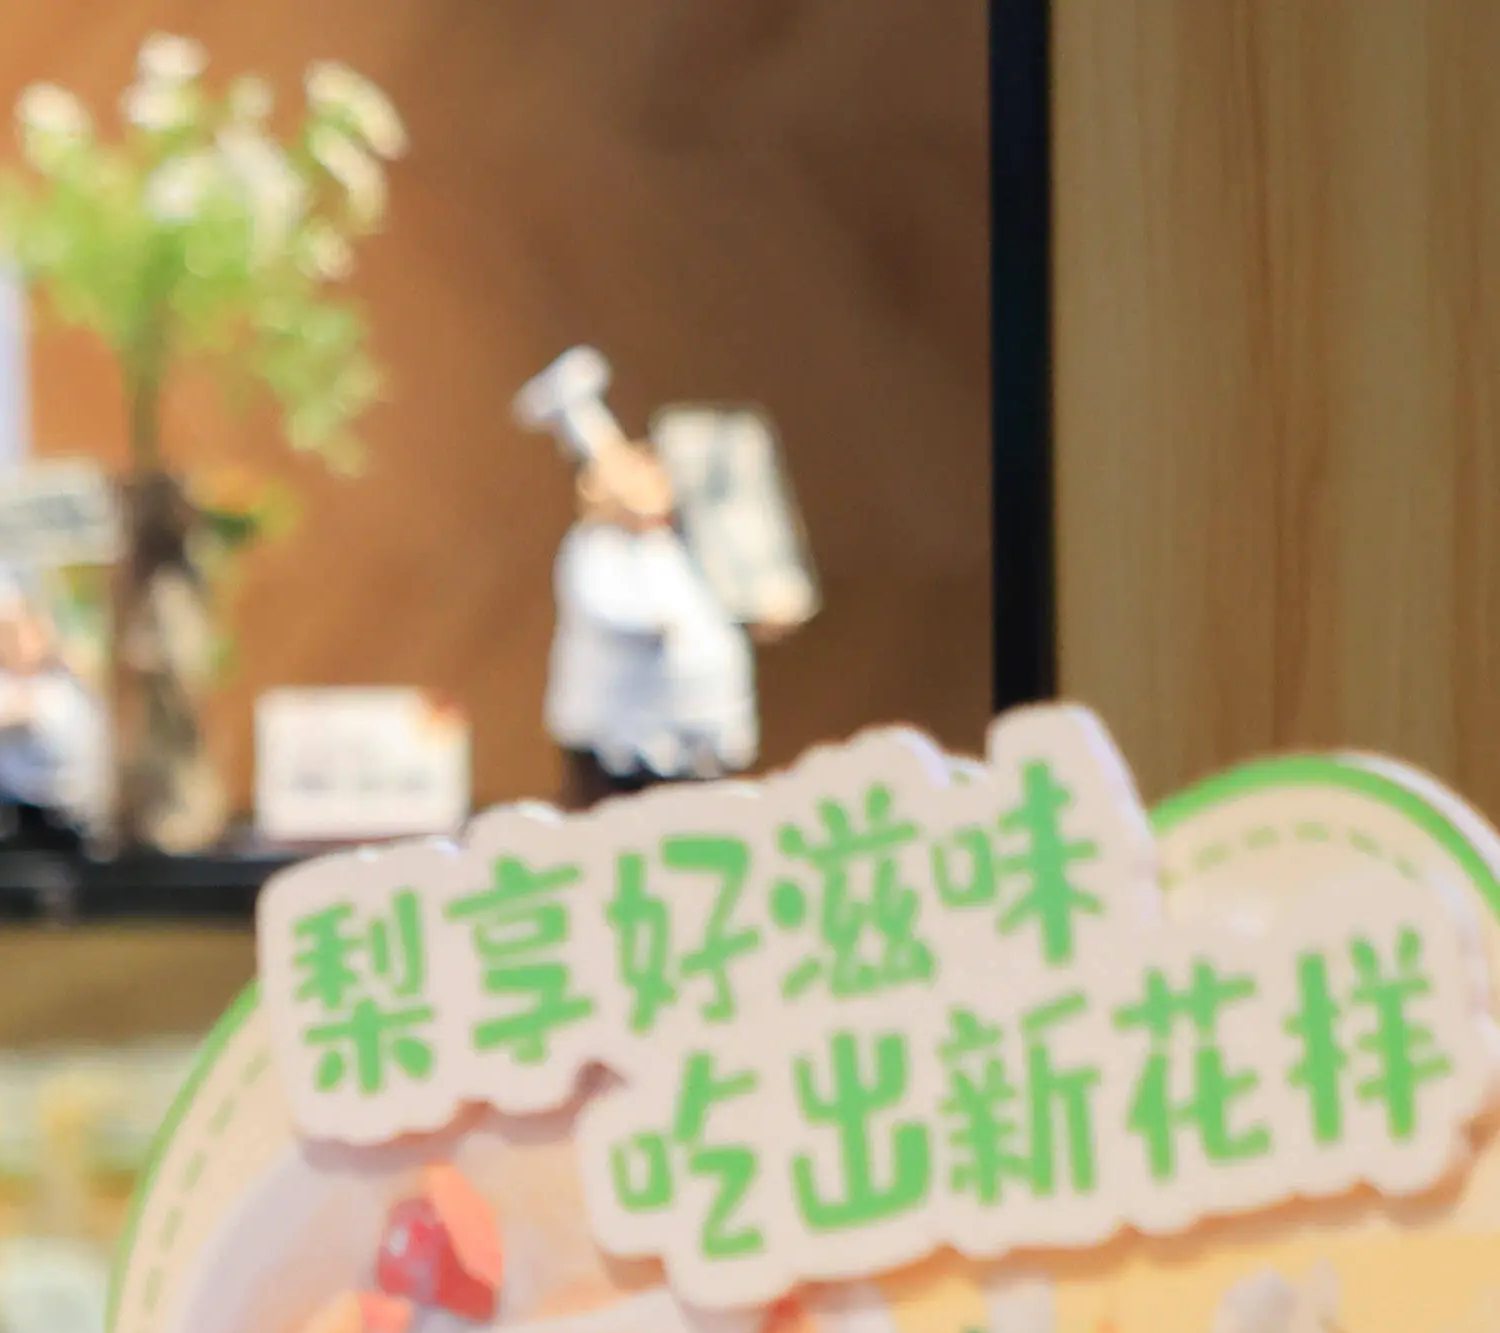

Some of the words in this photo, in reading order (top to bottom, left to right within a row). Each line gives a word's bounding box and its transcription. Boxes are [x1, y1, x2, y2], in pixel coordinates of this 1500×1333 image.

[290, 758, 1107, 1095] 梨享好滋味
[611, 928, 1453, 1260] 吃出新花样
